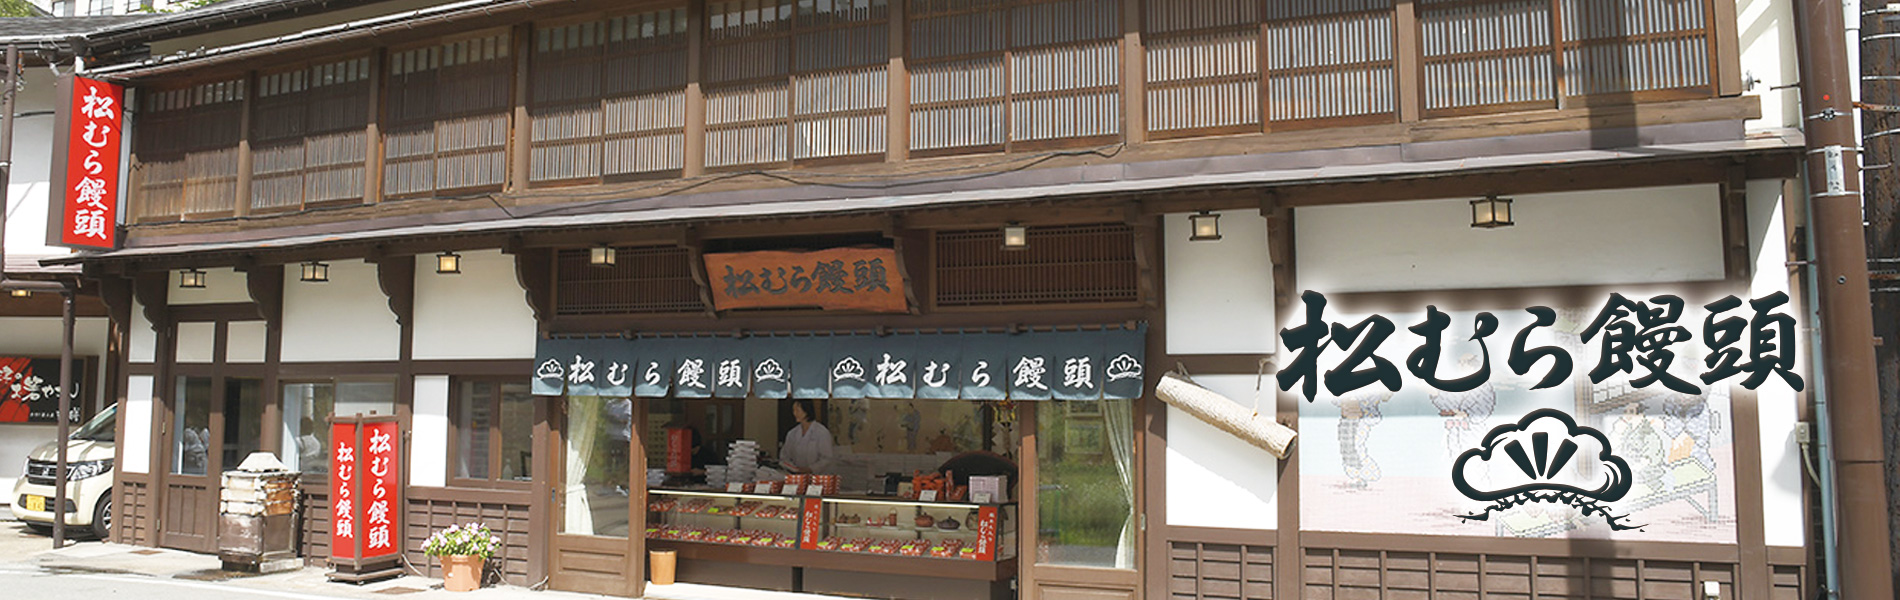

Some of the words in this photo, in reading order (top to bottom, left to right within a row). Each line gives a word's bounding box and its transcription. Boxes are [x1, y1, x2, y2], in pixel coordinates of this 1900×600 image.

[73, 86, 115, 240] 松むら饅頭
[723, 257, 891, 299] 松むら饅頭
[568, 354, 744, 389] 松むら饅頭
[874, 353, 1094, 391] 松むら饅頭
[336, 441, 355, 539] 松むら饅頭
[367, 428, 392, 549] 松むら饅頭
